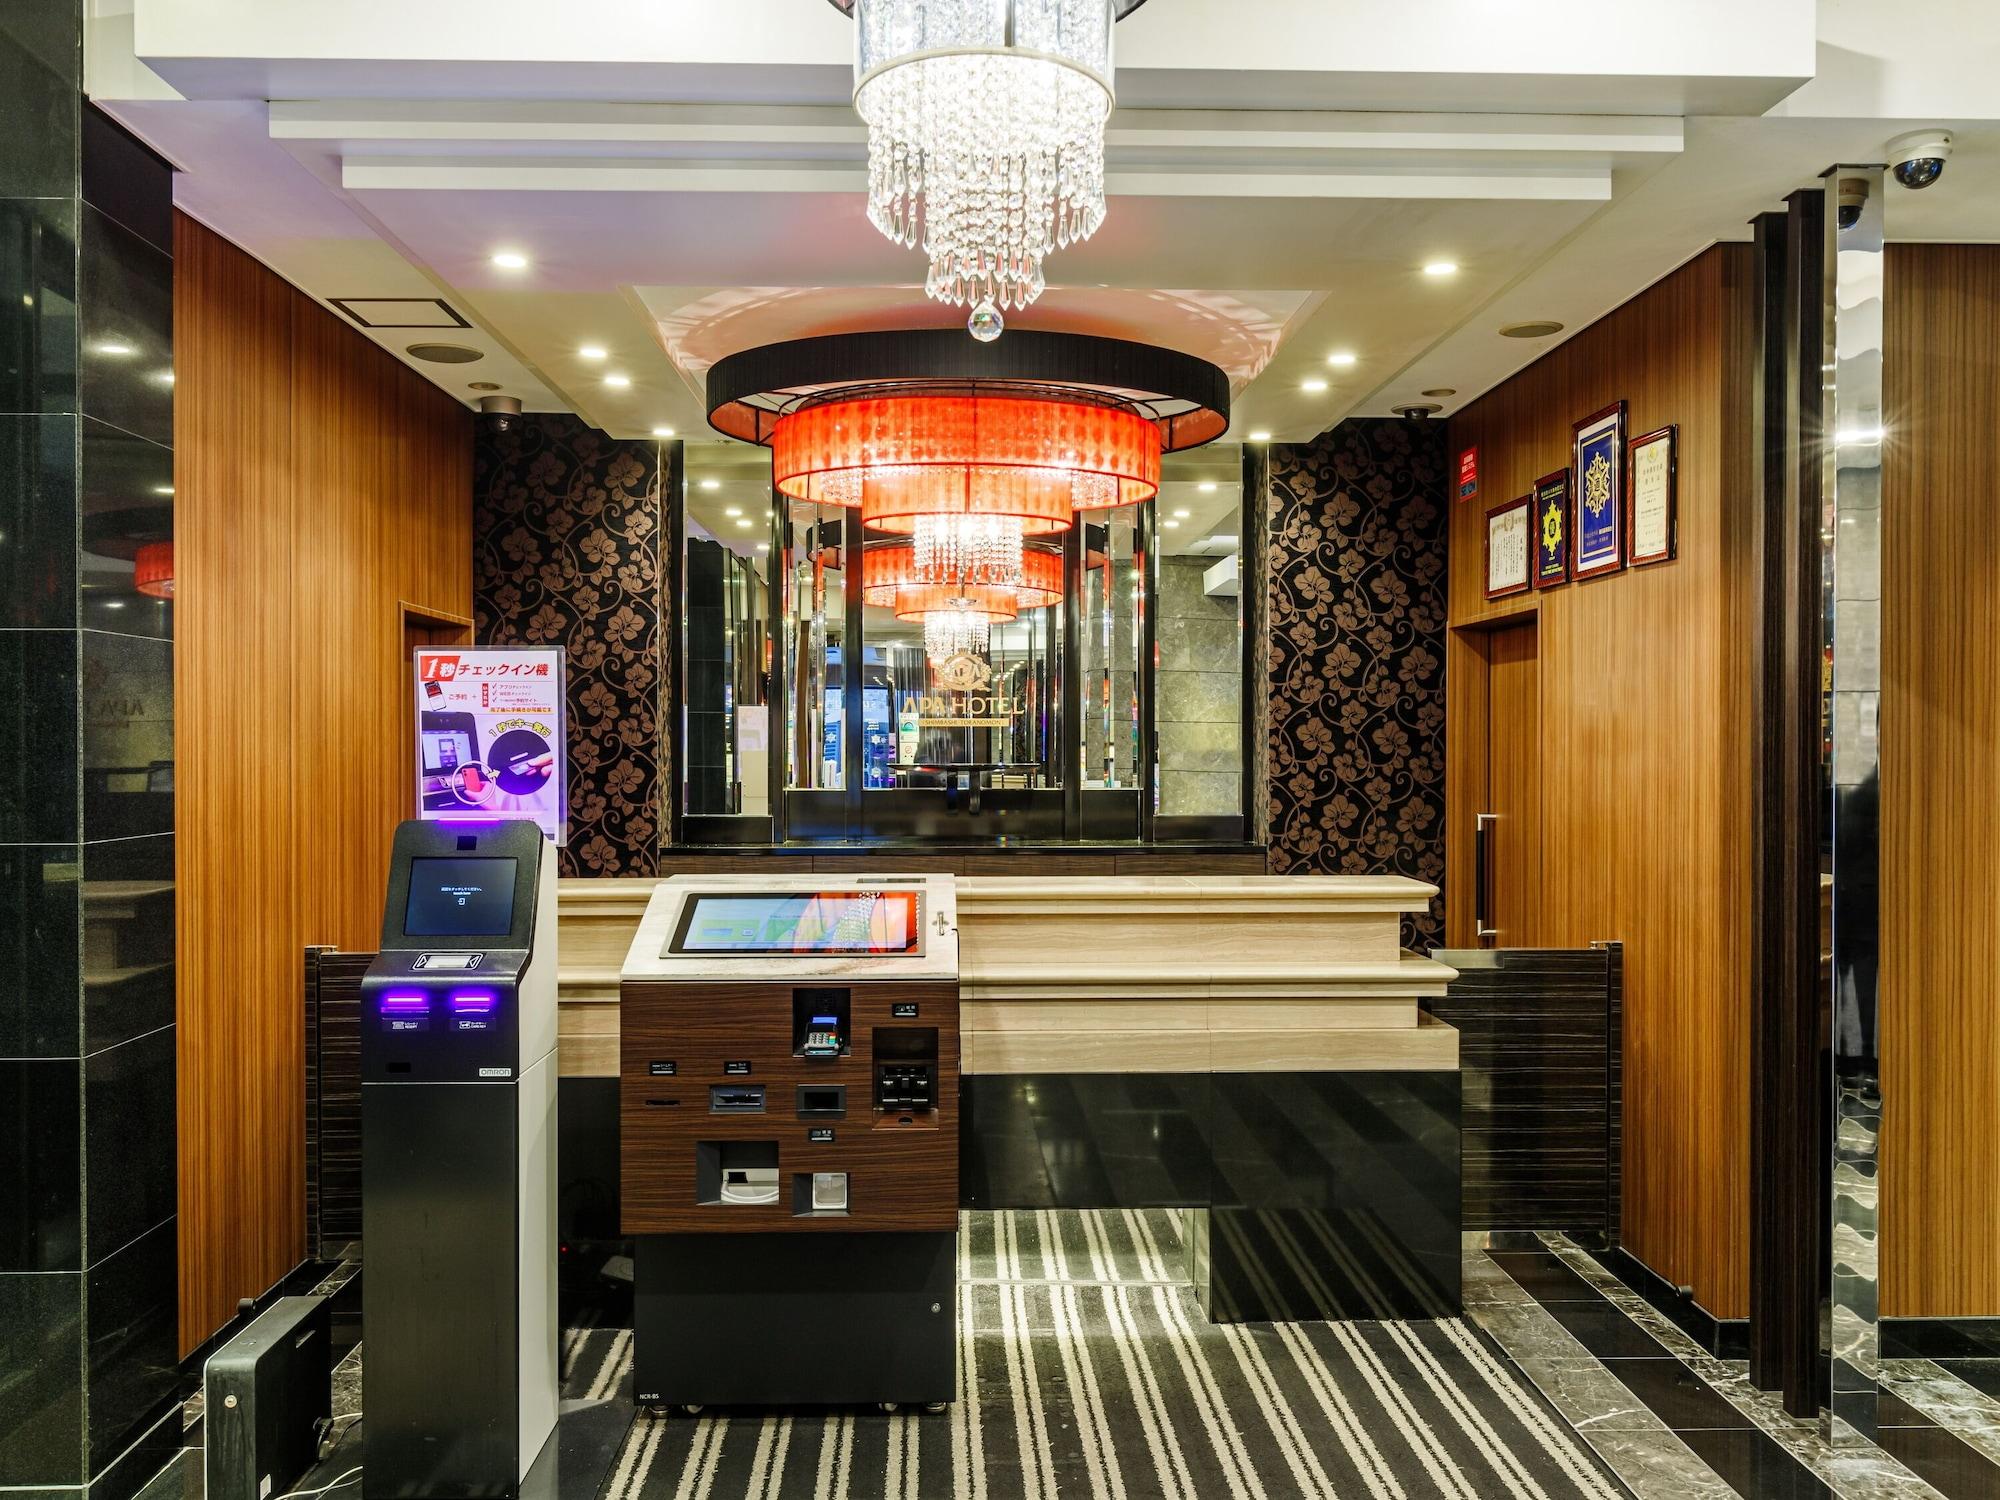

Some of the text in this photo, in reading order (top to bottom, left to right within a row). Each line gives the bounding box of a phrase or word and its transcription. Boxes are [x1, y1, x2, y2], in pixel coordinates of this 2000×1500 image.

[902, 697, 1025, 715] APA HOTEL
[480, 1068, 511, 1076] OMRON
